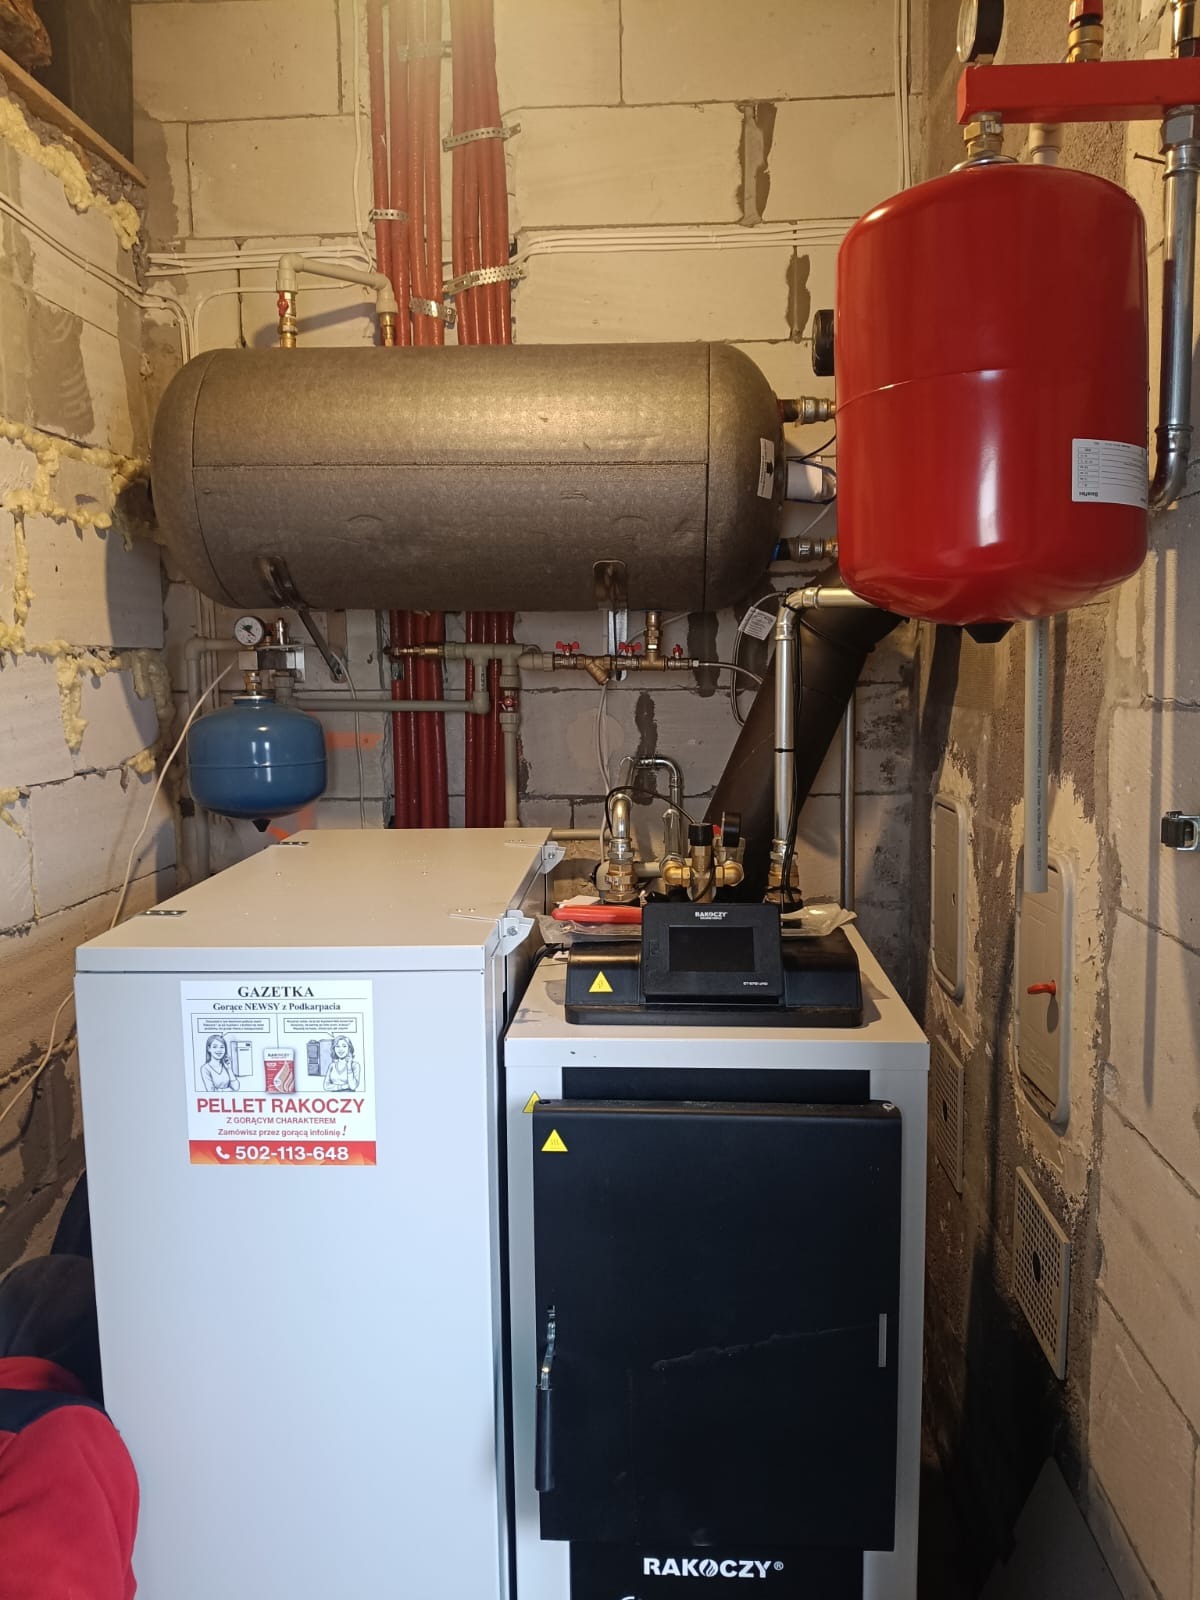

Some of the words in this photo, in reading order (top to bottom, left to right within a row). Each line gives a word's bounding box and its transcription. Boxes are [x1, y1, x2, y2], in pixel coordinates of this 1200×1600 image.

[237, 986, 314, 998] GAZETKA
[213, 1002, 243, 1012] Gorące
[245, 1002, 280, 1011] NEWSY
[289, 1002, 341, 1012] Podkarpacia
[197, 1098, 266, 1113] PELLET
[271, 1098, 365, 1113] RAKOCZY
[233, 1117, 274, 1125] GORĄCYM
[218, 1128, 257, 1136] Zamówisz
[235, 1145, 349, 1161] 502-113-648
